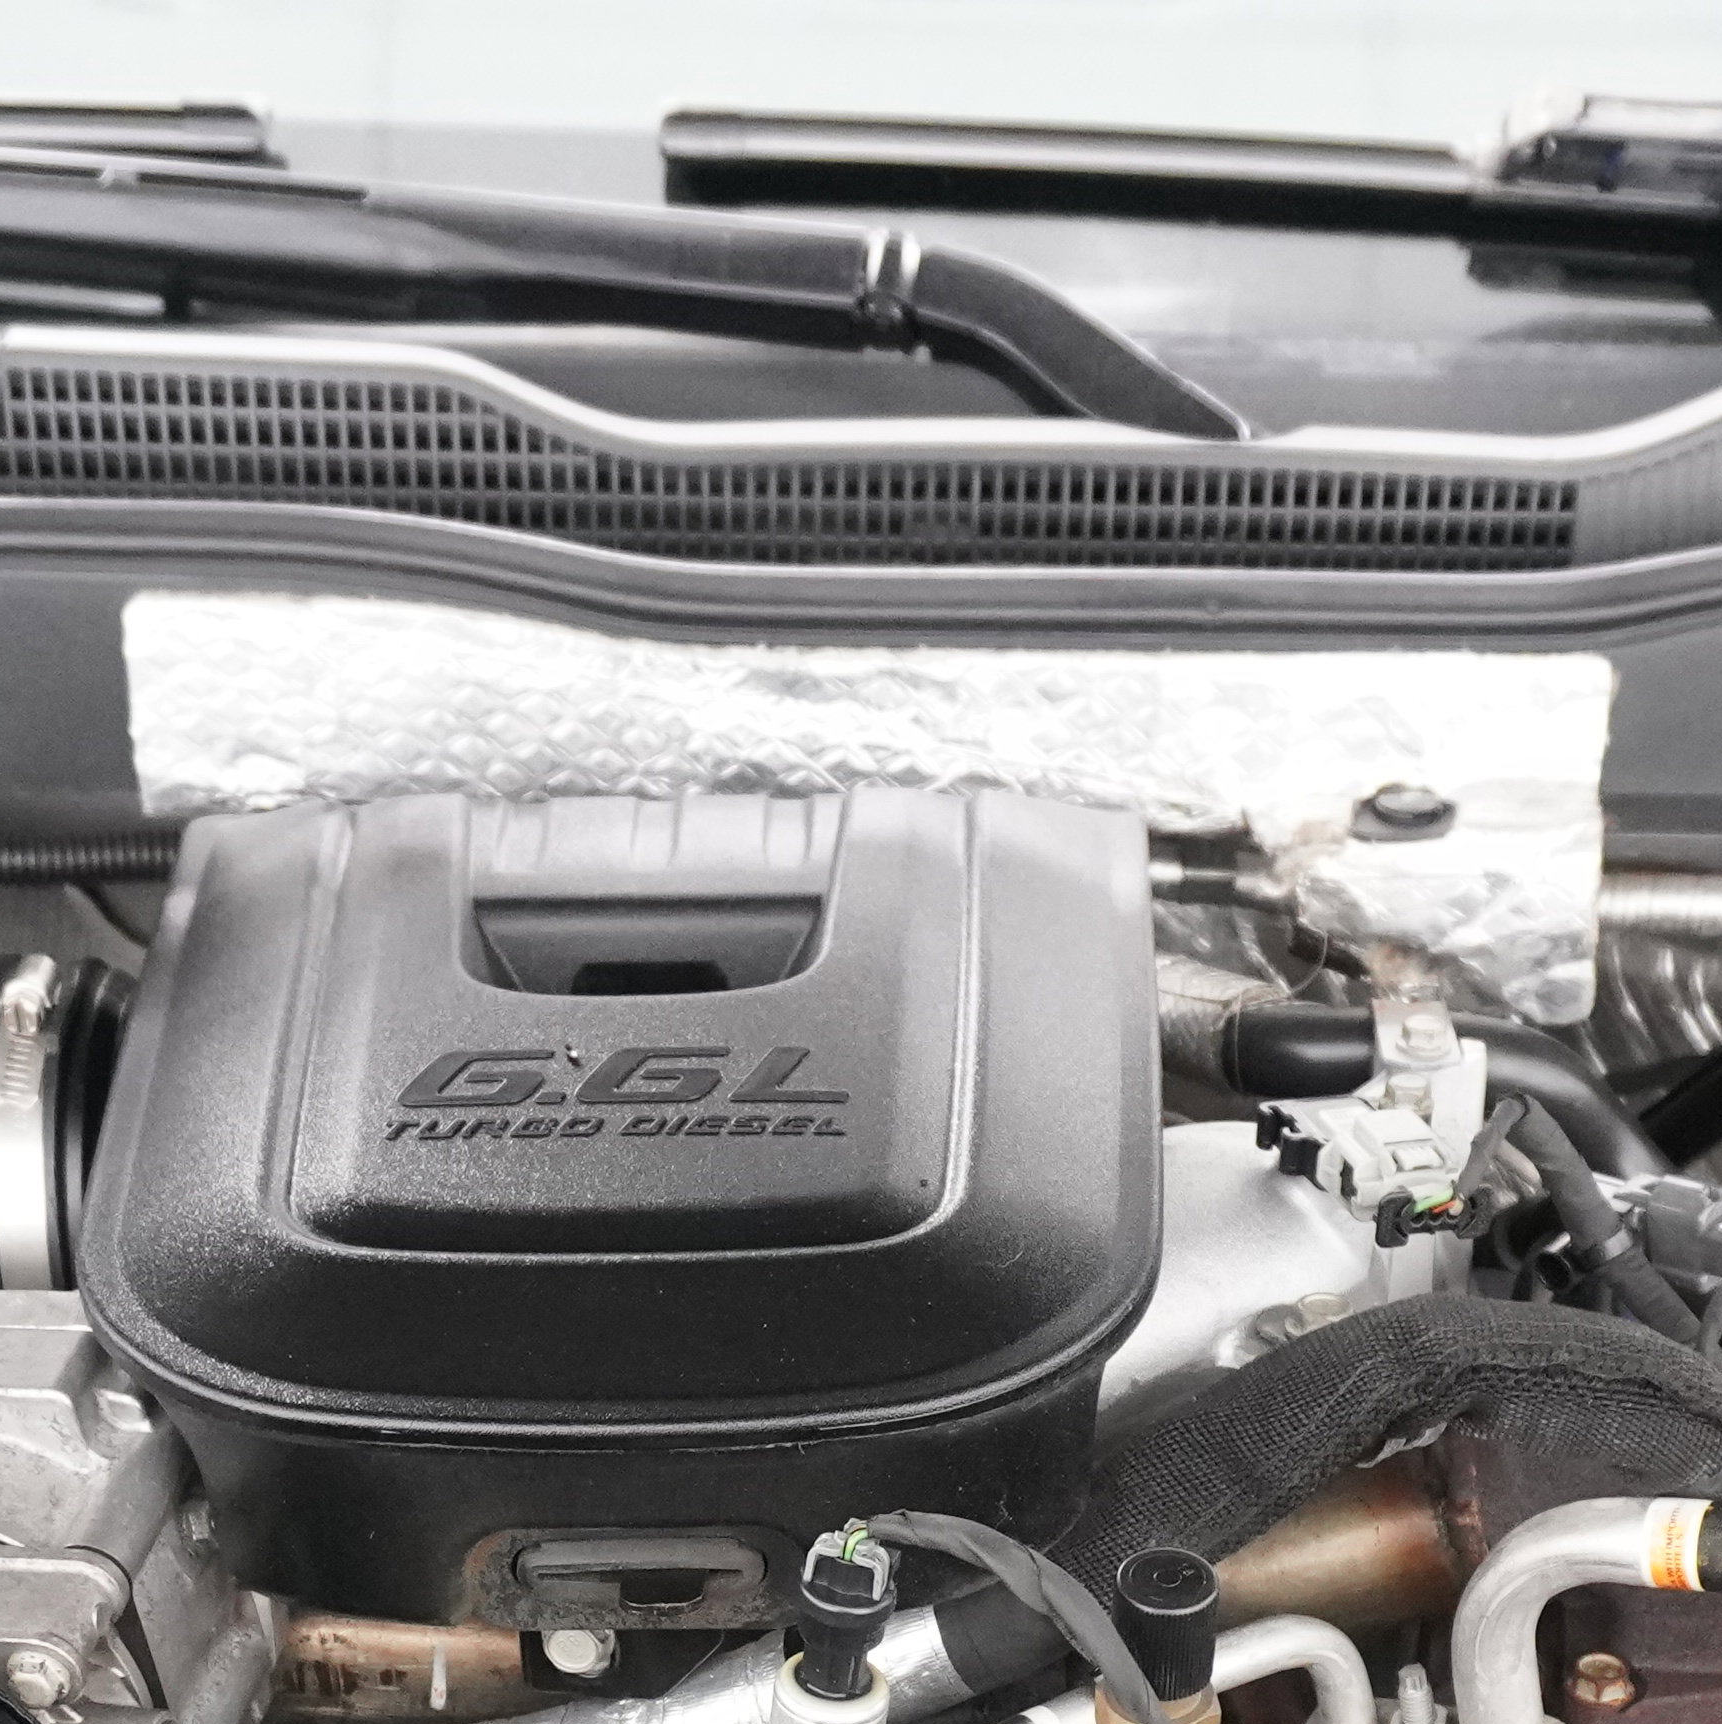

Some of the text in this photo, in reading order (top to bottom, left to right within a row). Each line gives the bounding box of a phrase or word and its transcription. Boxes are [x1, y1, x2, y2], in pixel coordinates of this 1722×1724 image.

[396, 1047, 850, 1107] 6.6L
[384, 1114, 847, 1141] TURBO DIESEL
